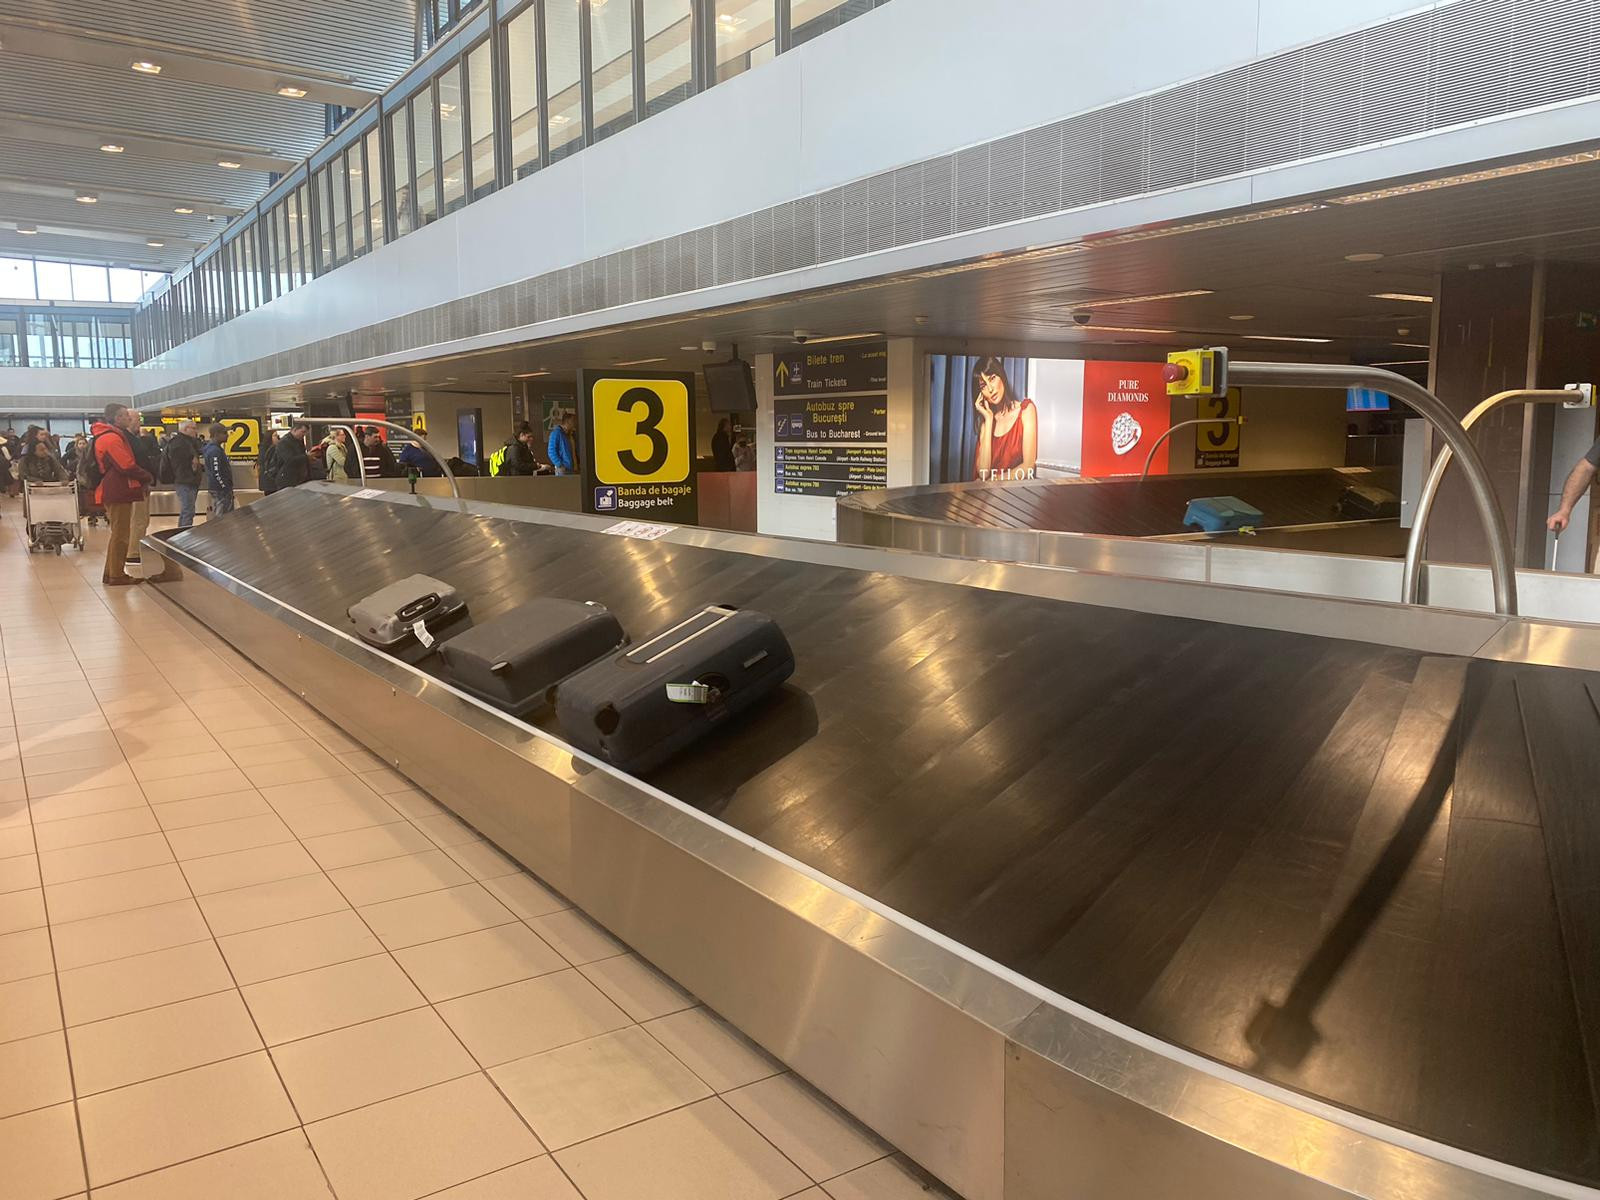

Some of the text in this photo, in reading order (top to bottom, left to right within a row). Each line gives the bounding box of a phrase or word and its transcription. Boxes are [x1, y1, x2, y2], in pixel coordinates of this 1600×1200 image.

[807, 354, 845, 365] Bilete tren
[807, 380, 822, 388] Train
[825, 378, 847, 387] Tickets
[1119, 380, 1139, 389] PURE
[1108, 392, 1149, 403] DIAMONDS
[806, 402, 855, 412] Autobuz spre
[1208, 396, 1230, 446] 3
[617, 387, 668, 475] 3
[806, 430, 817, 438] Bus
[829, 429, 860, 438] Bucharest
[230, 422, 251, 452] 2
[980, 468, 1034, 482] TEILOR
[618, 485, 691, 496] Banda de bagaje
[618, 497, 673, 508] Baggage belt
